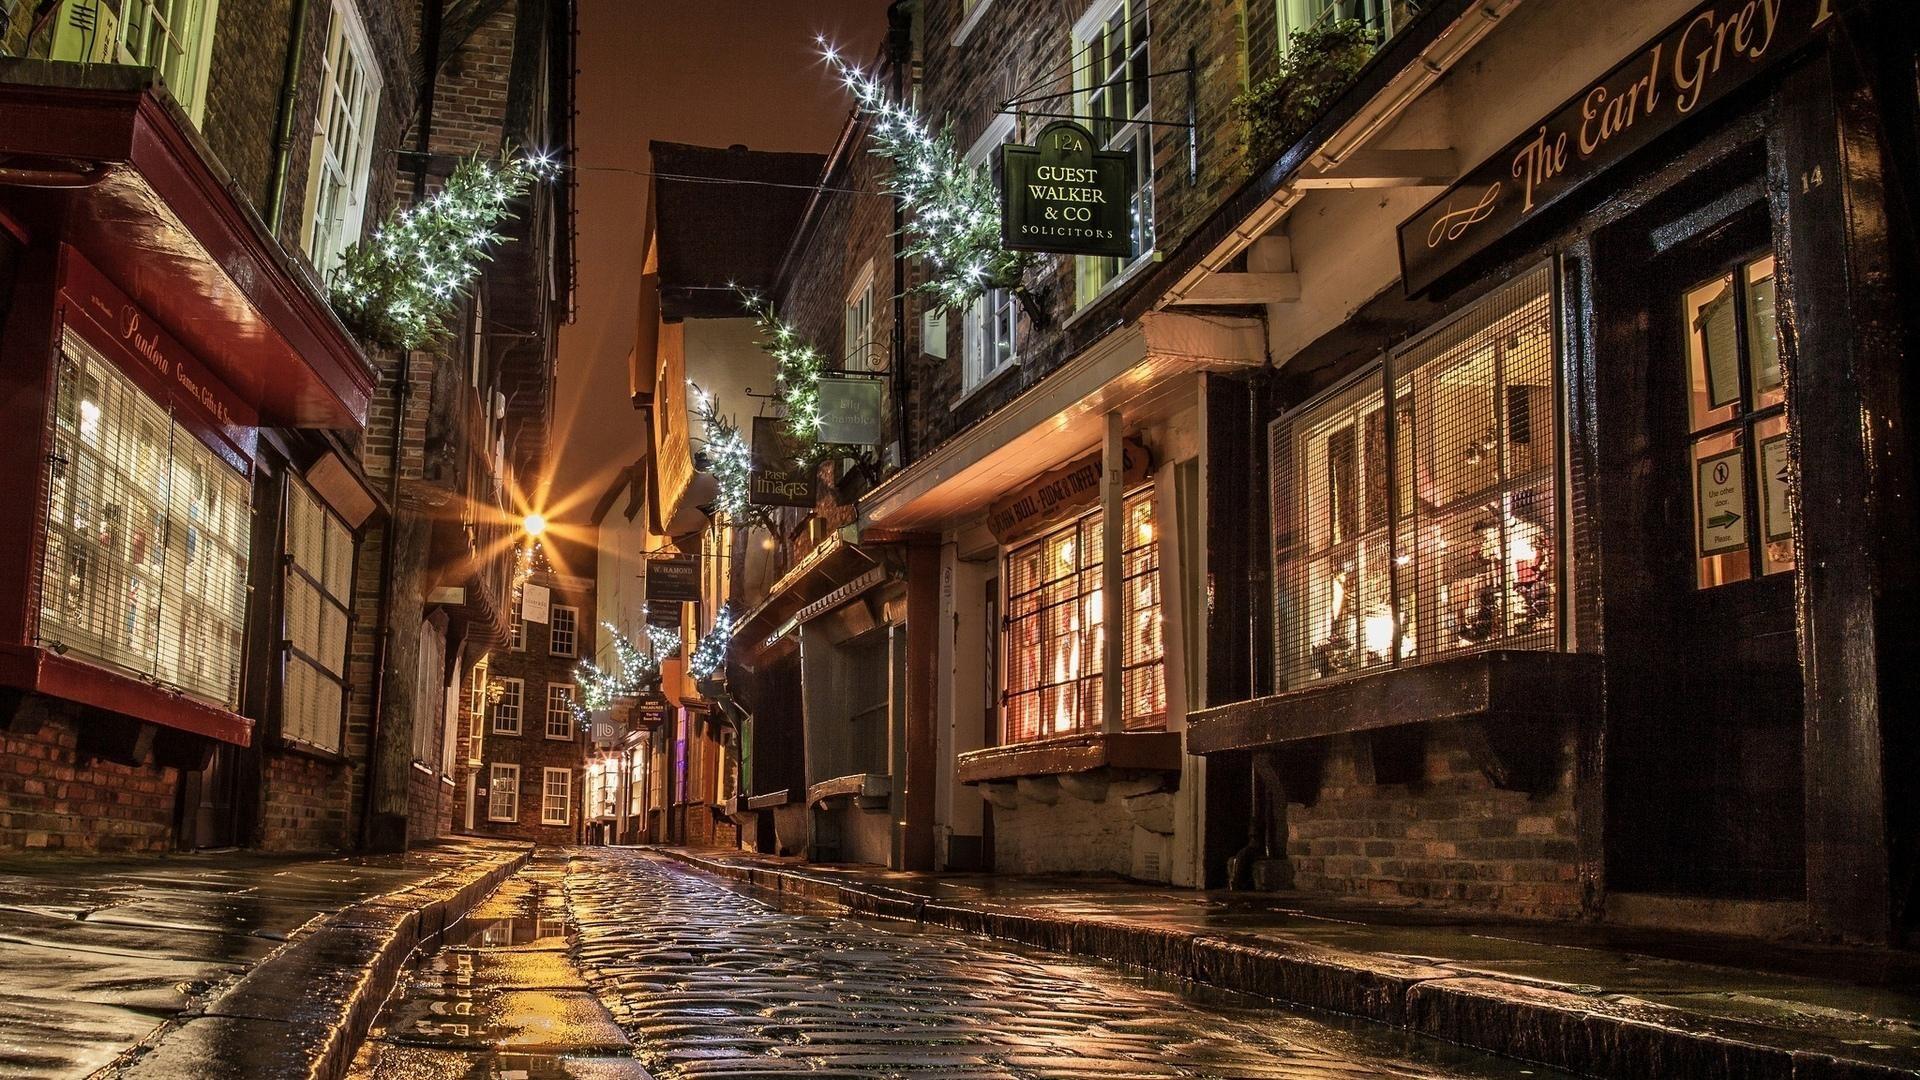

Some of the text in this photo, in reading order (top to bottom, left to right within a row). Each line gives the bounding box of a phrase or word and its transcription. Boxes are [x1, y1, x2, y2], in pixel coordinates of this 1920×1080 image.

[1512, 0, 1782, 213] The Earl Grey
[1052, 133, 1083, 152] 12A
[1037, 165, 1098, 184] GUEST
[1801, 164, 1823, 195] 14
[1028, 184, 1107, 204] WALKER
[1044, 206, 1092, 222] & CO
[1021, 224, 1114, 239] SOLICITORS
[120, 304, 170, 376] Pandora
[996, 507, 1016, 535] JOHN
[1013, 495, 1039, 522] BULL
[1038, 482, 1066, 509] FUDGE
[1067, 465, 1098, 494] TOFFEE
[1708, 486, 1735, 499] Use other
[1714, 499, 1730, 508] door.
[1714, 533, 1733, 544] Please.
